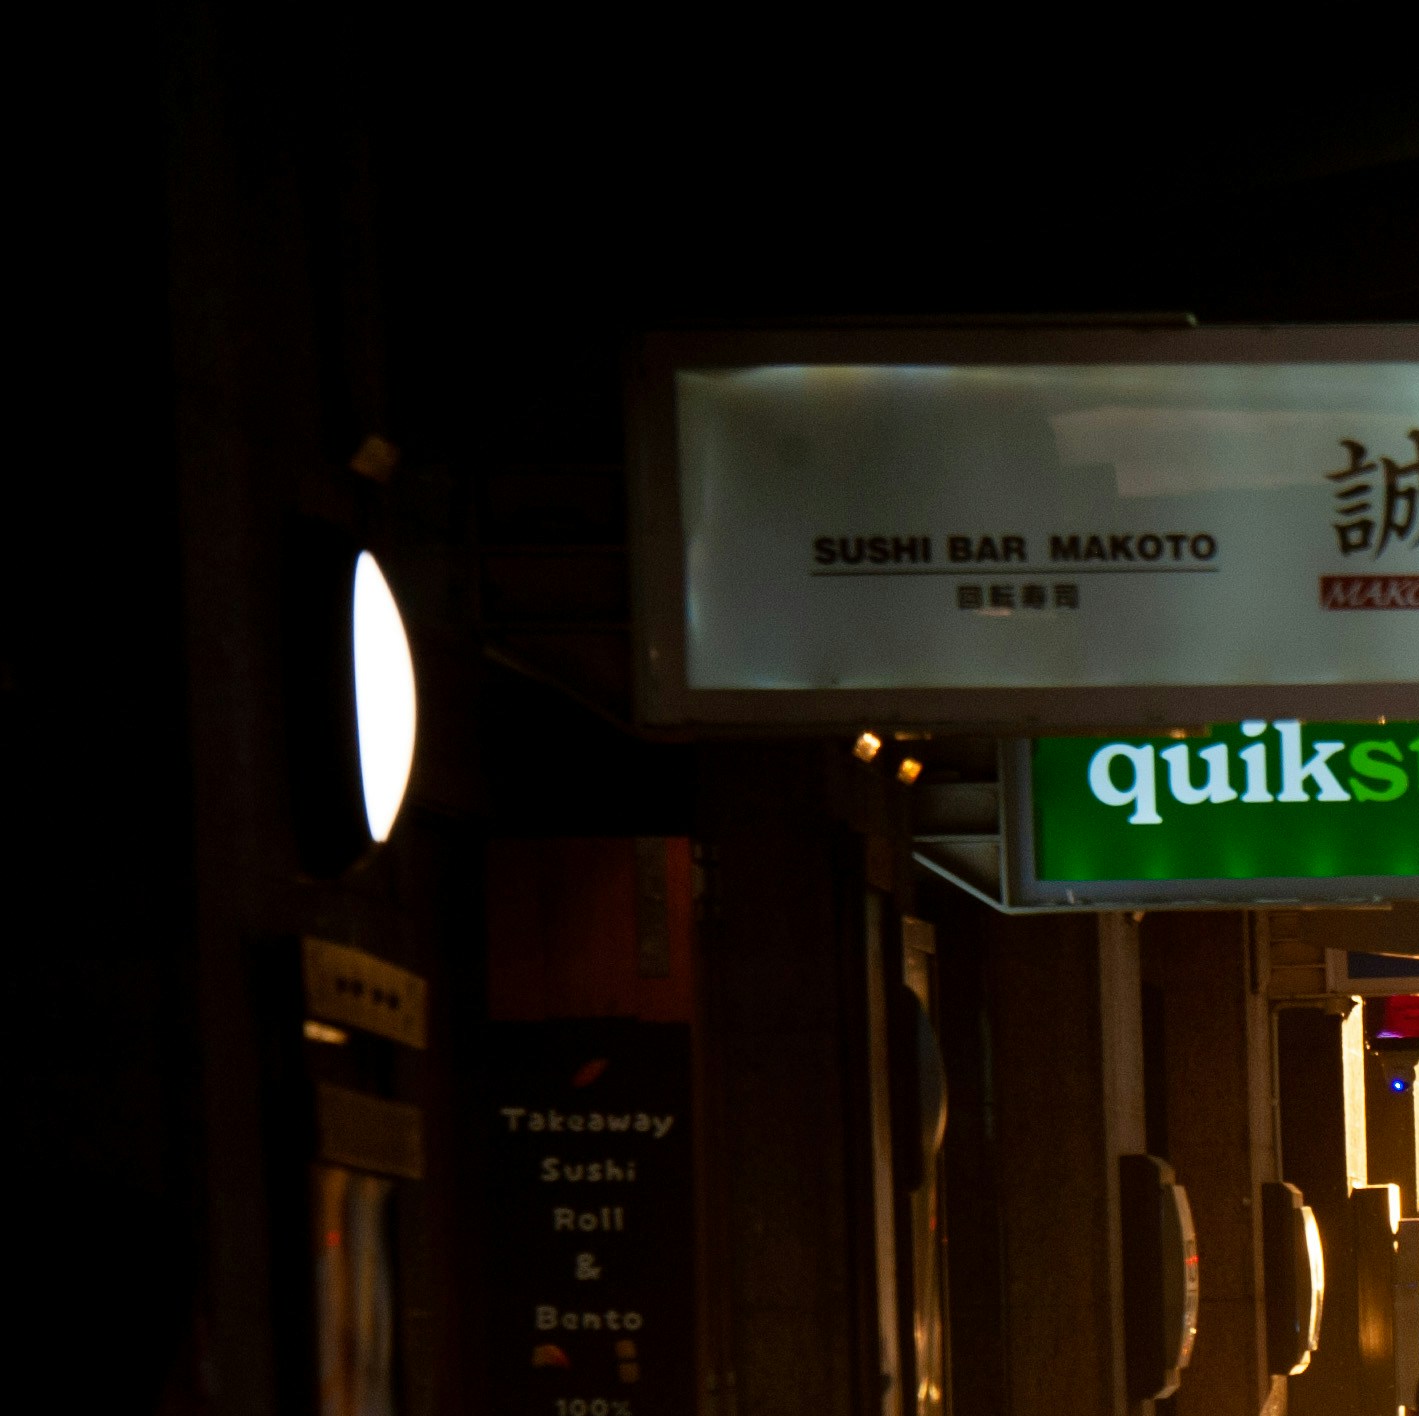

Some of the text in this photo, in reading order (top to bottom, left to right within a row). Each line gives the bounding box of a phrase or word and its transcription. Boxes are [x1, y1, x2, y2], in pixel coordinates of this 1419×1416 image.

[813, 531, 1218, 566] SUSHI BAR MAKOTO
[501, 1106, 675, 1140] Takeaway
[540, 1156, 638, 1184] Sushi
[553, 1206, 625, 1234] Roll
[574, 1253, 600, 1281] &
[535, 1305, 643, 1333] Bento
